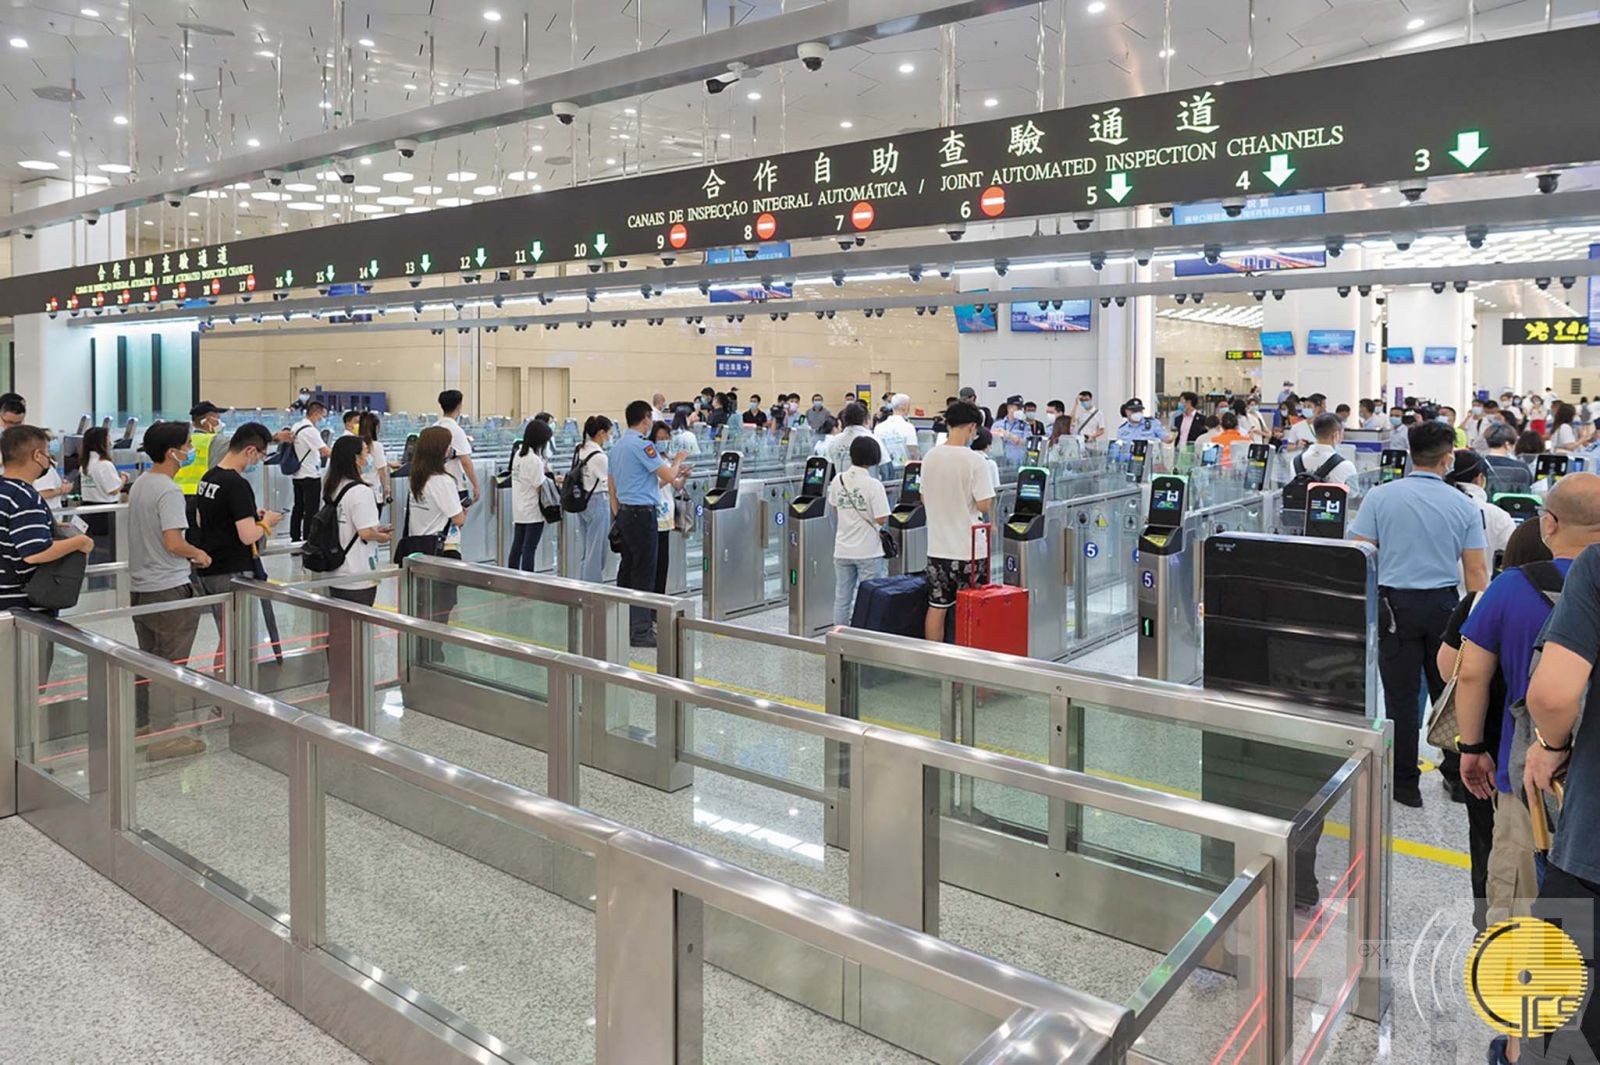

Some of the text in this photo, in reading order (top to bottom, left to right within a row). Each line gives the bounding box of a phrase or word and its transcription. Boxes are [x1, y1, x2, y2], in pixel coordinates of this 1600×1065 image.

[702, 91, 1220, 199] 合作自助查驗通道
[1414, 149, 1431, 172] 3
[627, 125, 1344, 229] CANAIS DE INSPECÇÃO INTEGRAL AUTOMÁTICA / JOINT AUTOMATED INSPECTION CHANNELS
[1235, 169, 1251, 190] 4
[1086, 186, 1098, 205] 5
[960, 201, 971, 219] 6
[835, 215, 844, 231] 7
[744, 225, 752, 240] 8
[656, 234, 664, 249] 9
[515, 250, 526, 263] 11
[574, 243, 587, 257] 10
[405, 262, 415, 274] 13
[460, 256, 471, 269] 12
[316, 271, 324, 283] 15
[359, 267, 368, 279] 14
[275, 276, 284, 288] 16
[777, 513, 783, 525] 8
[1086, 544, 1096, 557] 5
[1007, 557, 1014, 570] 6
[1144, 573, 1151, 587] 5
